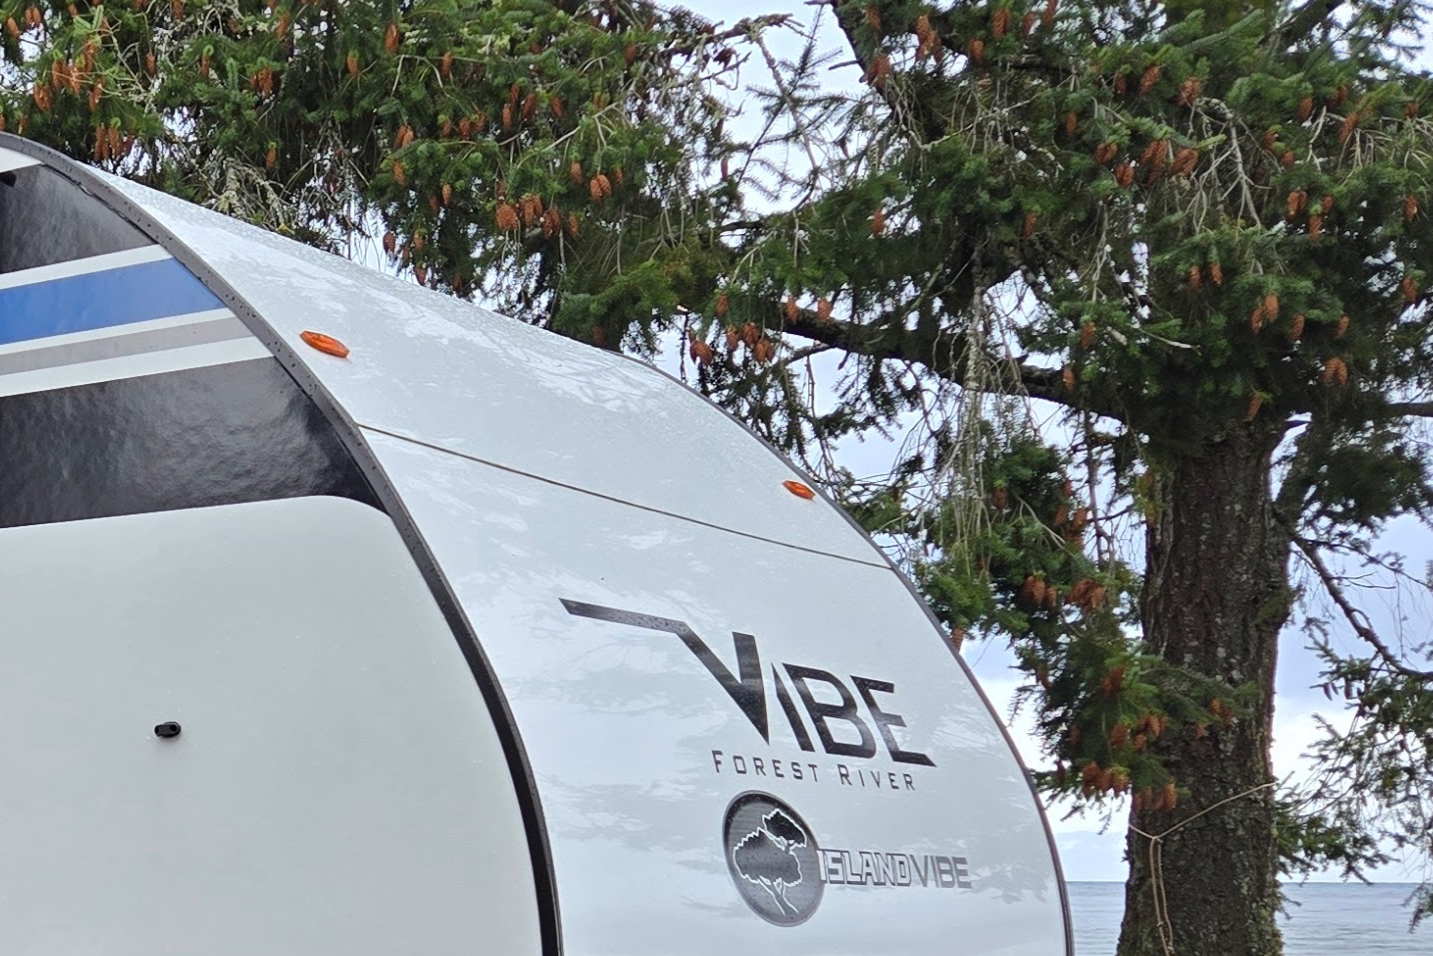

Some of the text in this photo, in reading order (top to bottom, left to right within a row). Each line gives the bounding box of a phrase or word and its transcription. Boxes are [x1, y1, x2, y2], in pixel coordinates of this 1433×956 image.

[559, 597, 937, 767] VIBE
[711, 750, 917, 791] FOREST RIVER
